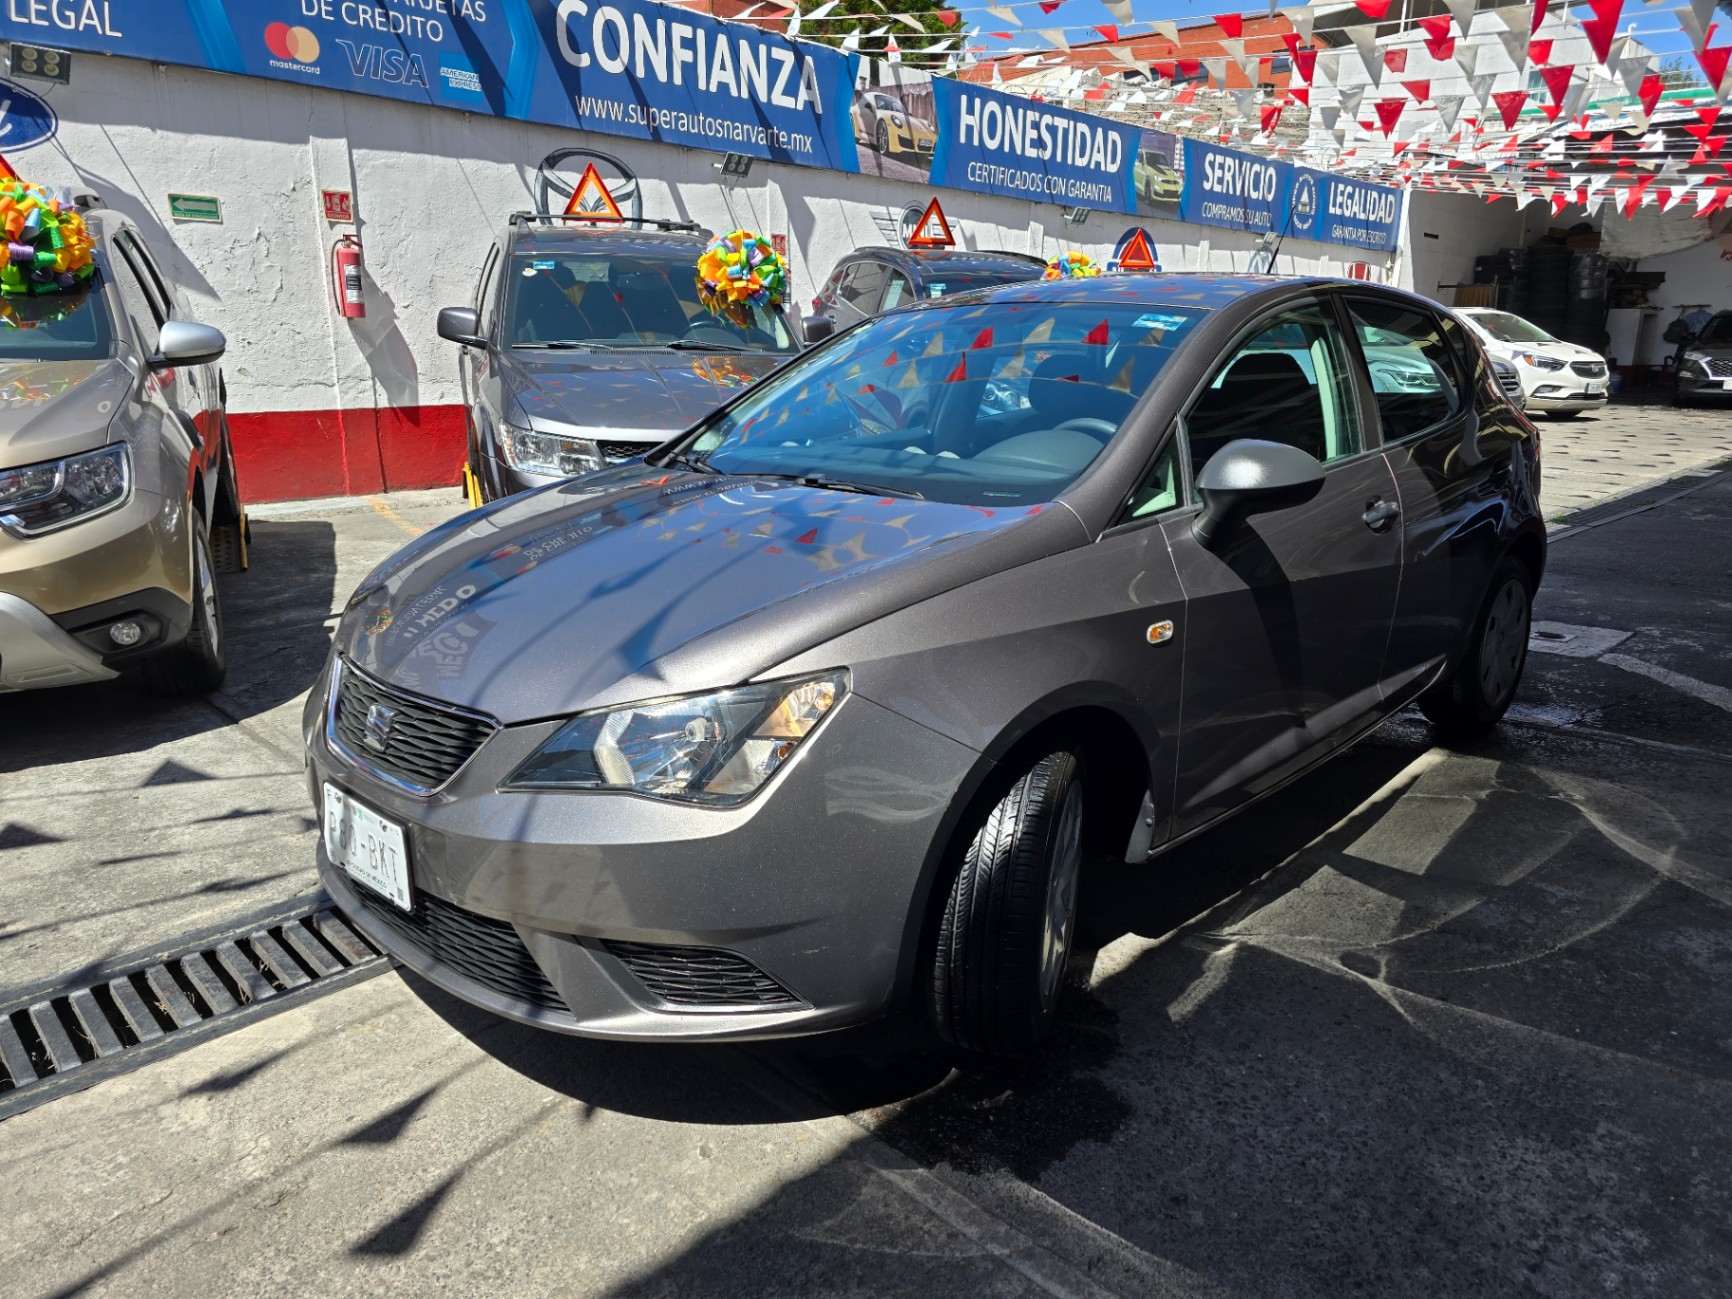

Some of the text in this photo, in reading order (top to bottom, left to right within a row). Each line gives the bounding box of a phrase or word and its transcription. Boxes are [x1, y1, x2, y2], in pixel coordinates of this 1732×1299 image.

[10, 0, 123, 37] LEGAL
[301, 0, 443, 42] DE CREDITO
[393, 0, 487, 22] JETAS
[269, 59, 320, 75] mastercard
[335, 38, 429, 88] VISA
[440, 67, 479, 81] AMERICAN
[556, 0, 823, 115] CONFIANZA
[575, 95, 812, 154] www.superautosnarvarte.mx
[959, 94, 1122, 173] HONESTIDAD
[967, 161, 1112, 203] CERTIFICADOS CON GARANTIA
[1203, 152, 1277, 202] SERVICIO
[1202, 202, 1272, 227] COMPRAMOS SU AUTO
[1328, 182, 1395, 224] LEGALIDAD
[1331, 224, 1357, 240] GARANTIA
